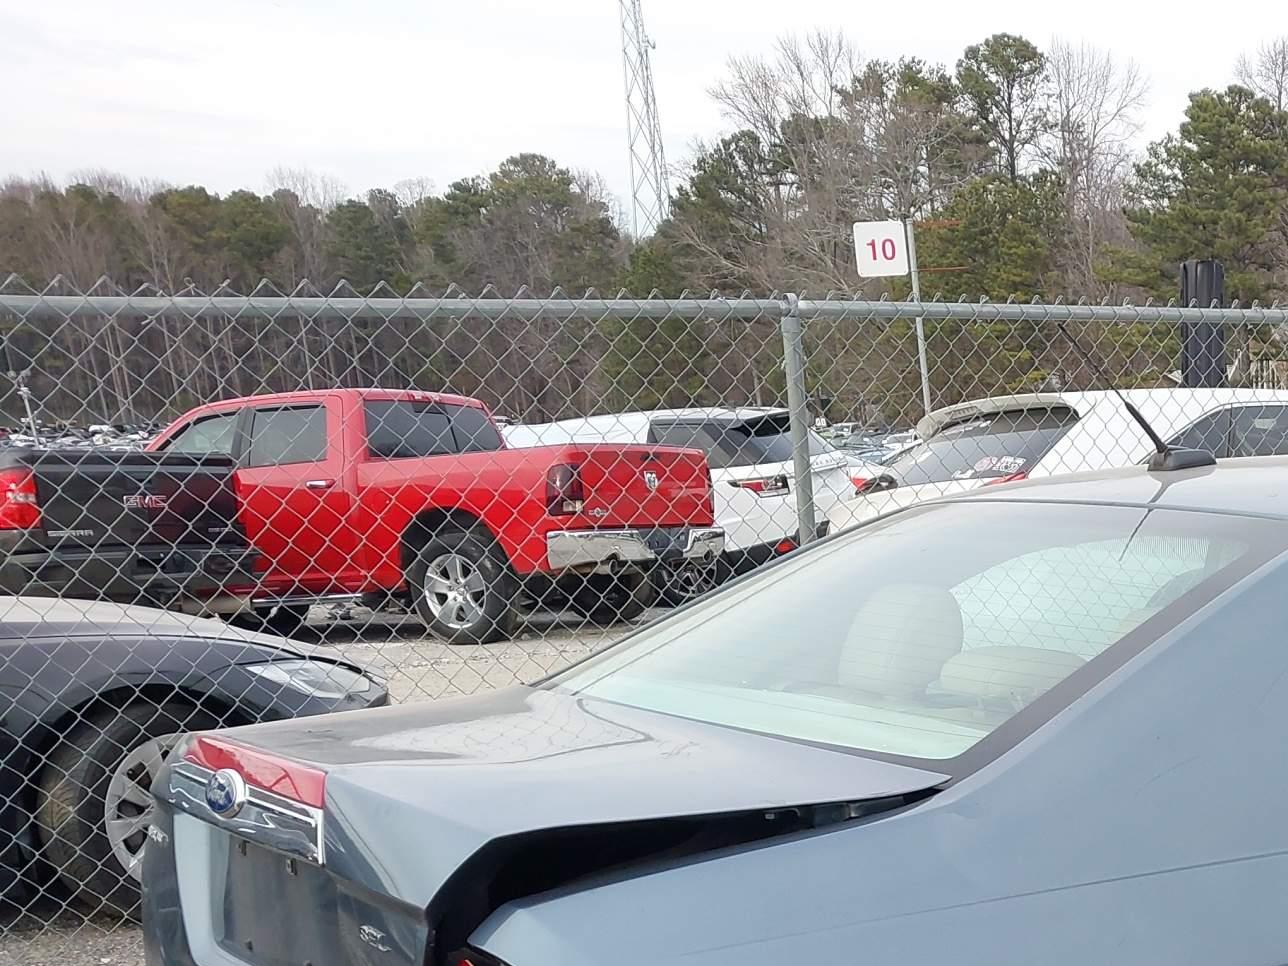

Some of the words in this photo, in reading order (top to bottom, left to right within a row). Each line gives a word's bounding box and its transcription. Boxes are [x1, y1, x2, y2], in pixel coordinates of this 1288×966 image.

[866, 238, 896, 261] 10
[122, 494, 168, 508] GMC
[360, 924, 392, 952] SEL
